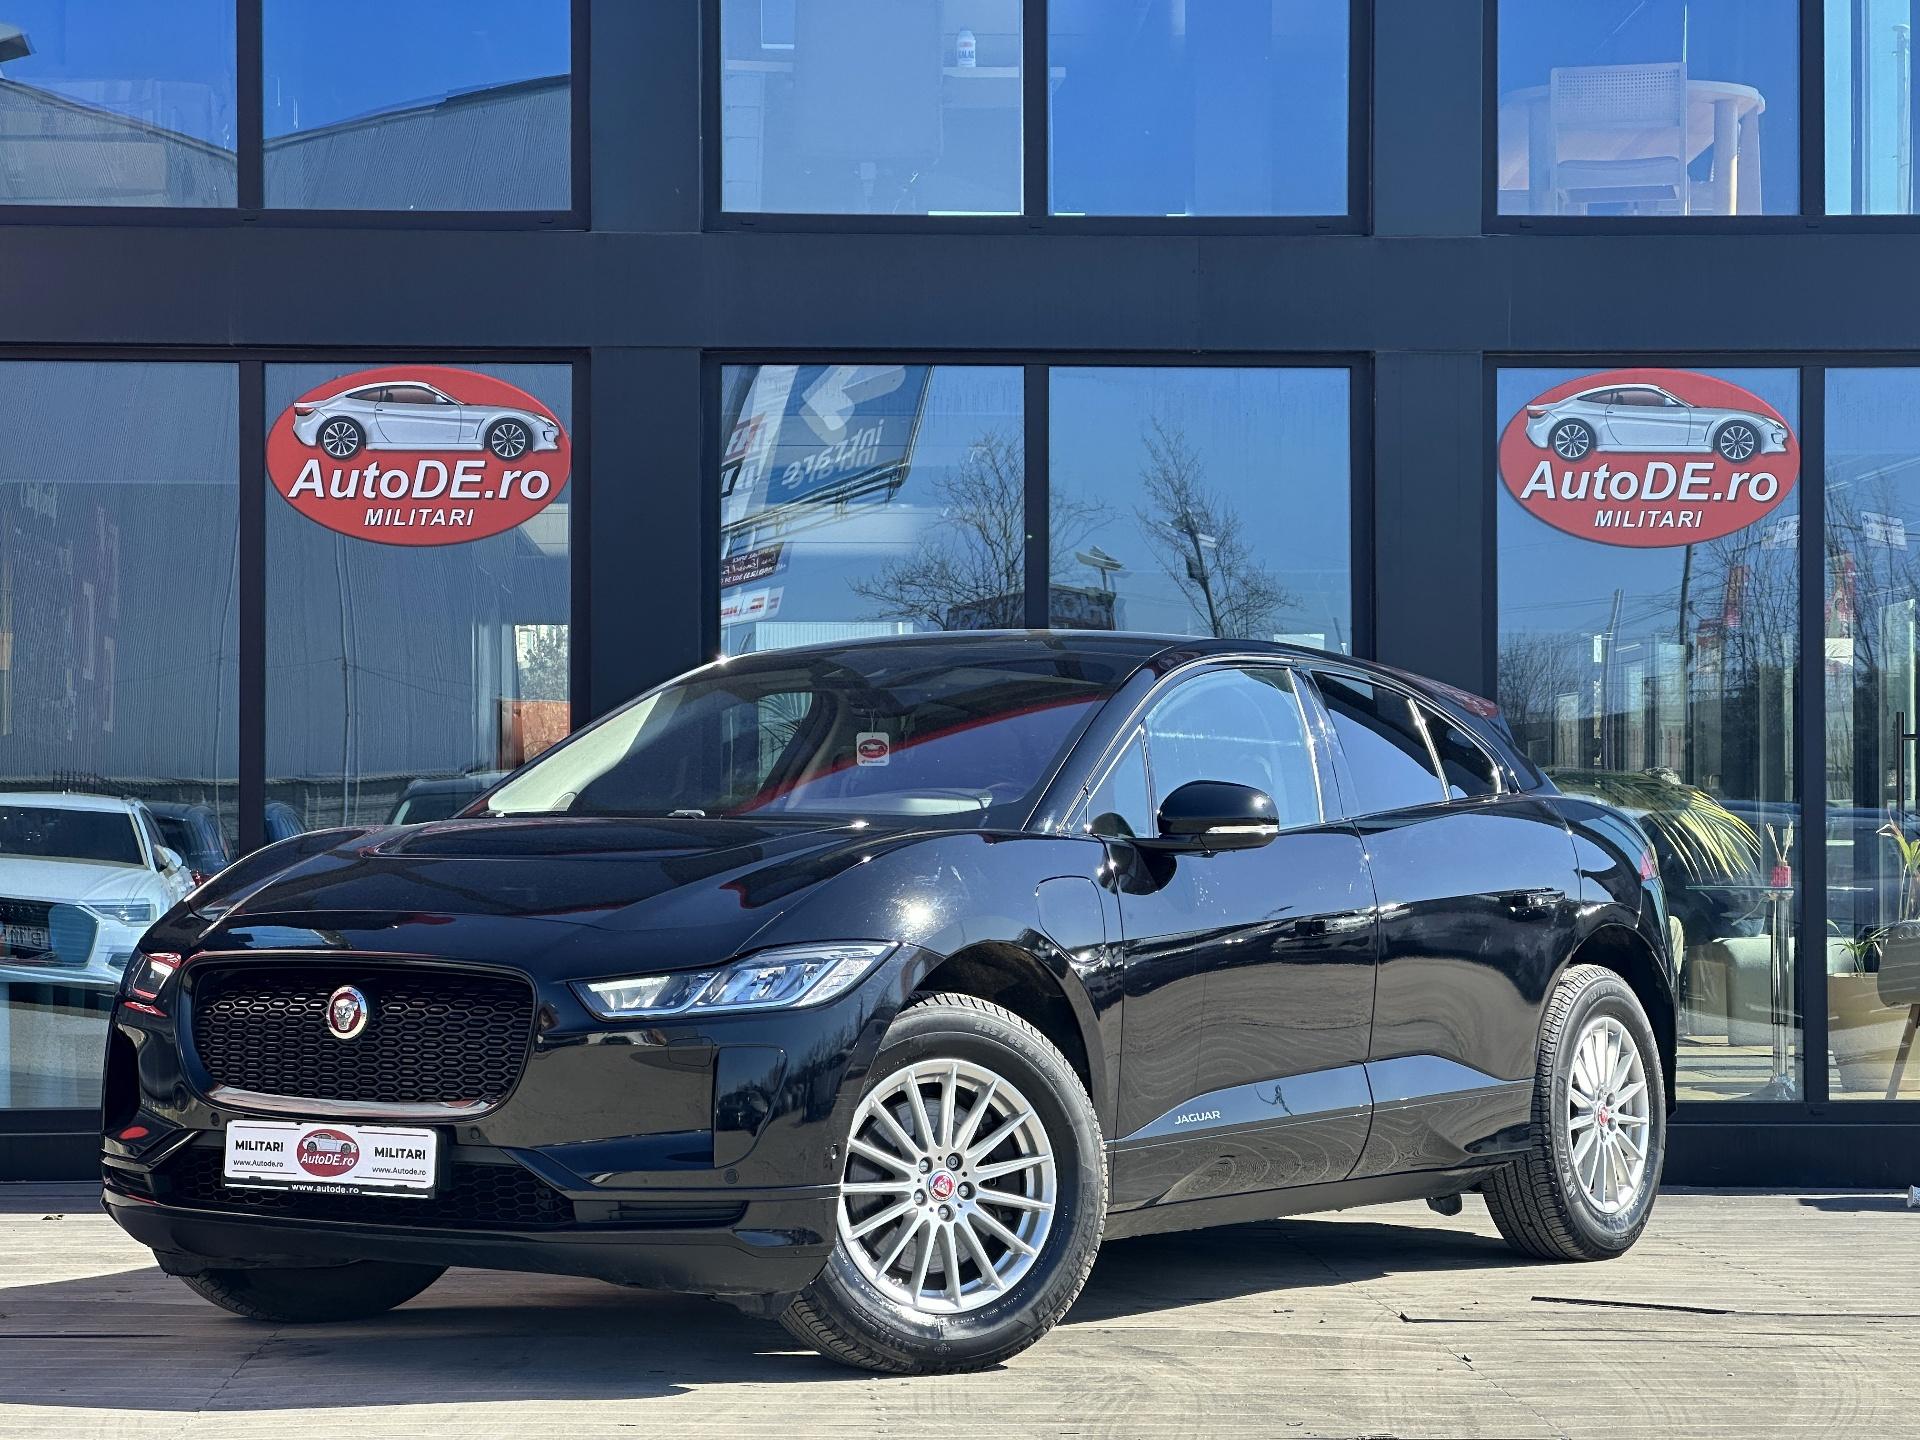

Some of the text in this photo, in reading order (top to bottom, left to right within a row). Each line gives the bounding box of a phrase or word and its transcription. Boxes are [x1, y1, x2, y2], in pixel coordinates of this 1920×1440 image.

[288, 459, 550, 499] AutoDE.ro
[1520, 460, 1779, 501] AutoDE.ro
[364, 508, 474, 526] MILITARI
[1594, 510, 1703, 528] MILITARI
[1175, 1111, 1221, 1125] JAGUAR
[235, 1140, 284, 1153] MILITARI
[300, 1153, 355, 1166] AutoDE.ro
[374, 1147, 426, 1160] MILITARI
[233, 1159, 284, 1168] www.Autode.ro
[372, 1167, 427, 1176] www.Autode.ro
[291, 1184, 360, 1194] www.autode.ro
